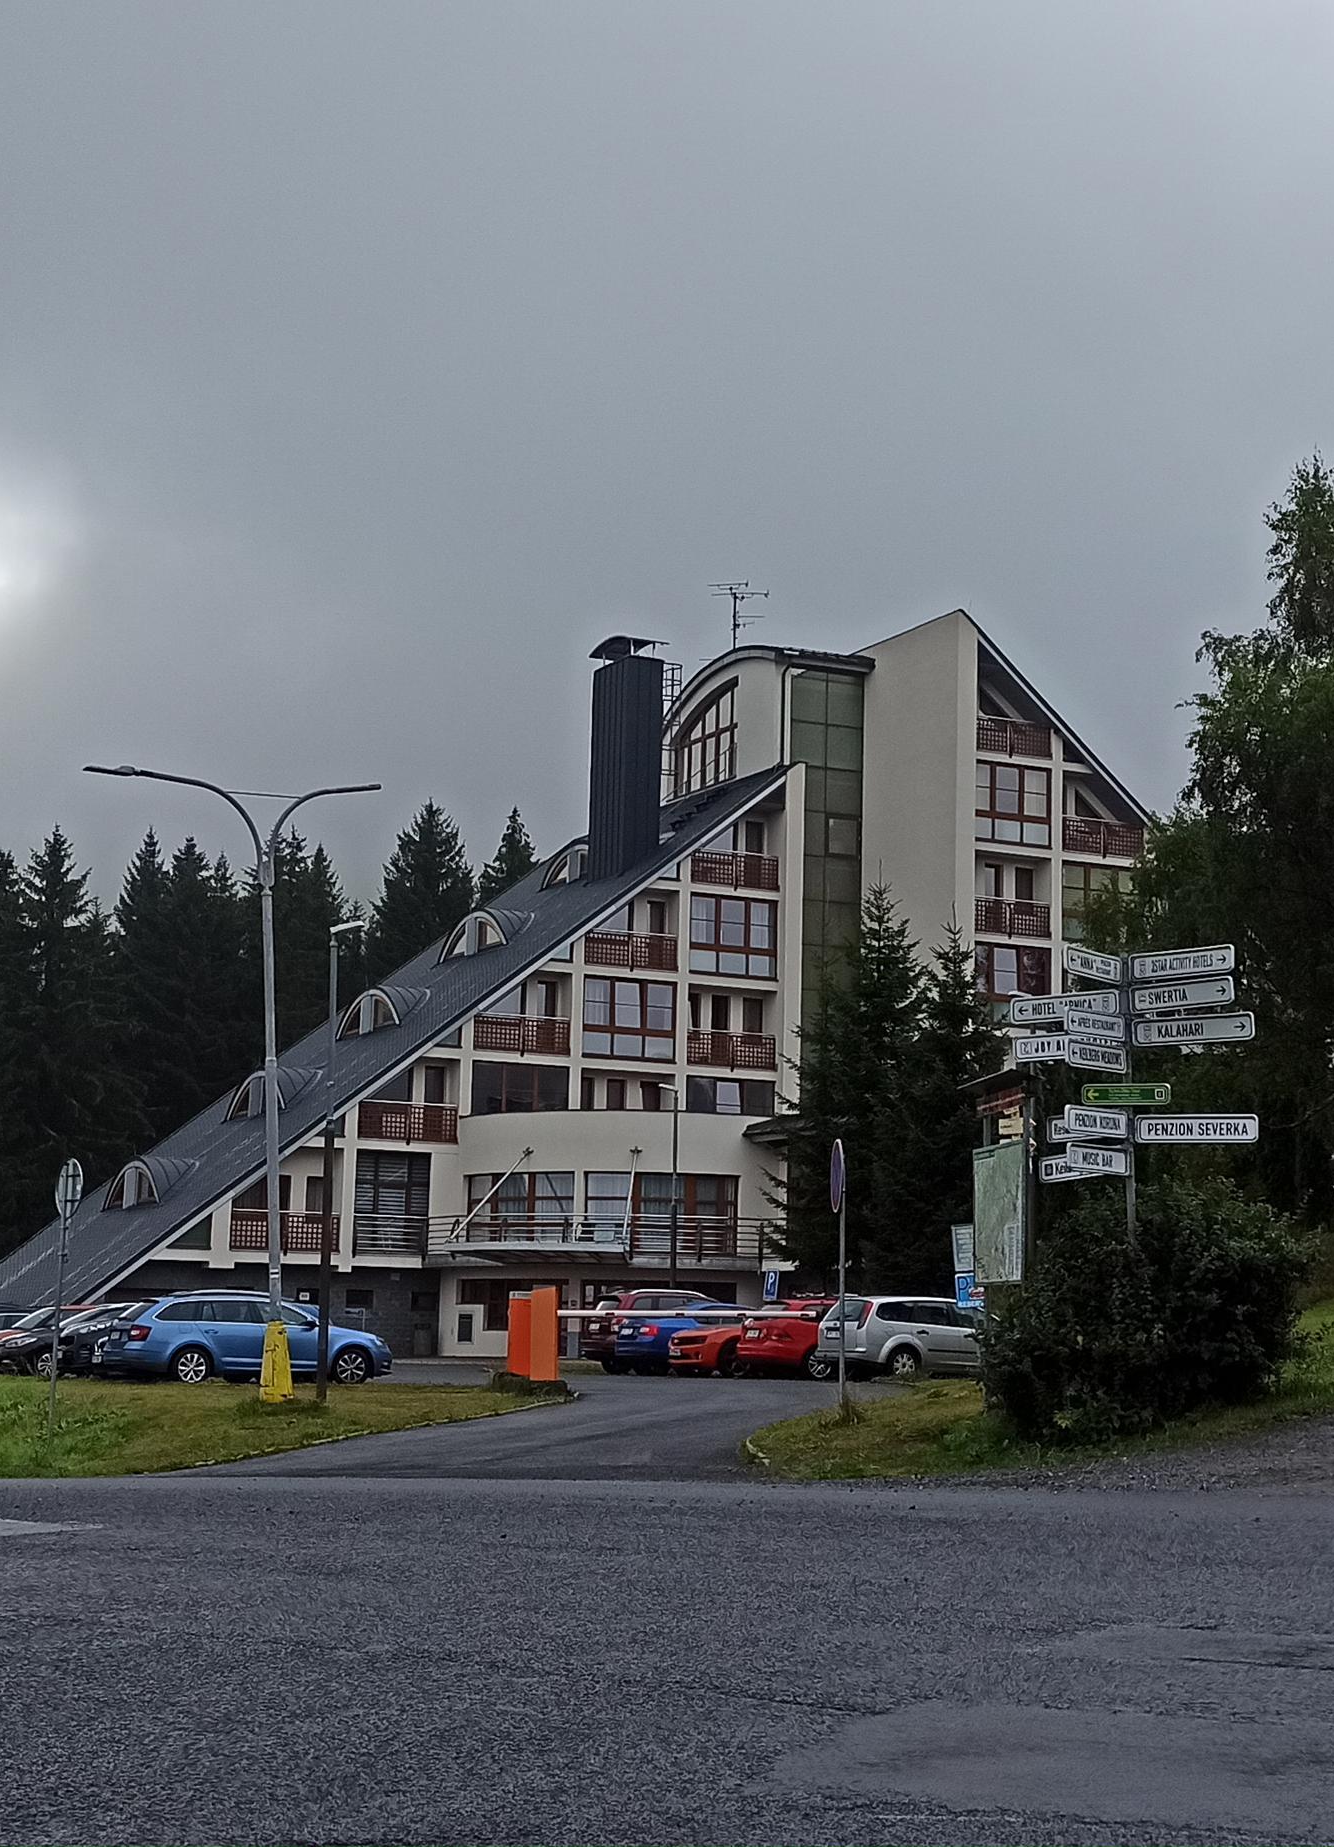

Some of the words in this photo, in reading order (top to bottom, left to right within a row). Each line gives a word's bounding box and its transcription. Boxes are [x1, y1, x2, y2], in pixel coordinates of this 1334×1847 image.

[1168, 957, 1192, 971] ACTIVITY
[1192, 954, 1214, 968] HOTELS
[1148, 988, 1188, 1005] SWERTIA
[1032, 1002, 1057, 1016] HOTEL
[1157, 1022, 1204, 1038] KALAHARI
[1034, 1041, 1053, 1053] JOY
[1074, 1113, 1097, 1128] PENZION
[1147, 1122, 1194, 1136] PENZION
[1198, 1122, 1249, 1136] SEVERKA
[1081, 1152, 1099, 1167] MUSIC
[1101, 1154, 1114, 1168] BAR
[768, 1272, 776, 1290] P
